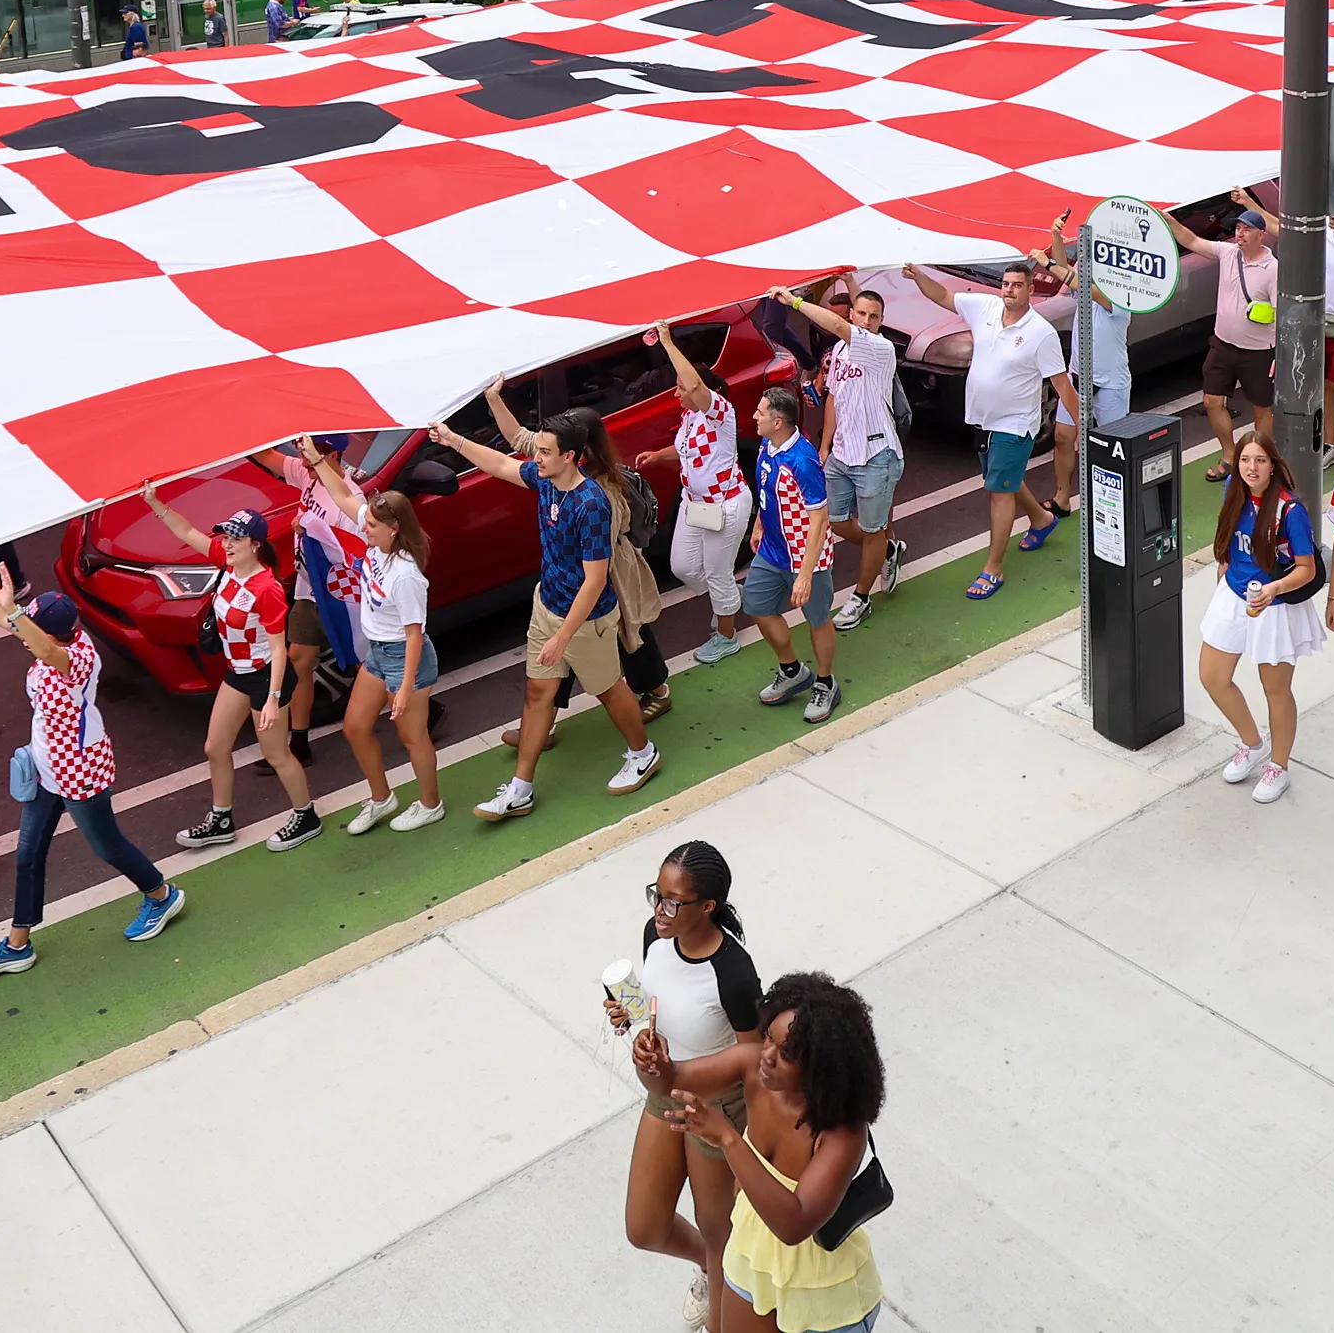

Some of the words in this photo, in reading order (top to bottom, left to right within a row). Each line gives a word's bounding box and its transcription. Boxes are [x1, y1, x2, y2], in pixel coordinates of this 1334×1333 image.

[1110, 200, 1127, 211] PAY
[1127, 204, 1149, 216] WITH
[1096, 233, 1114, 243] Parking
[1114, 237, 1126, 246] Zone
[1096, 242, 1162, 277] 913401
[1105, 278, 1116, 287] PAY
[1122, 283, 1139, 294] PLATE
[1145, 289, 1163, 299] KIOSK
[1111, 440, 1126, 461] A
[1234, 530, 1253, 556] 10
